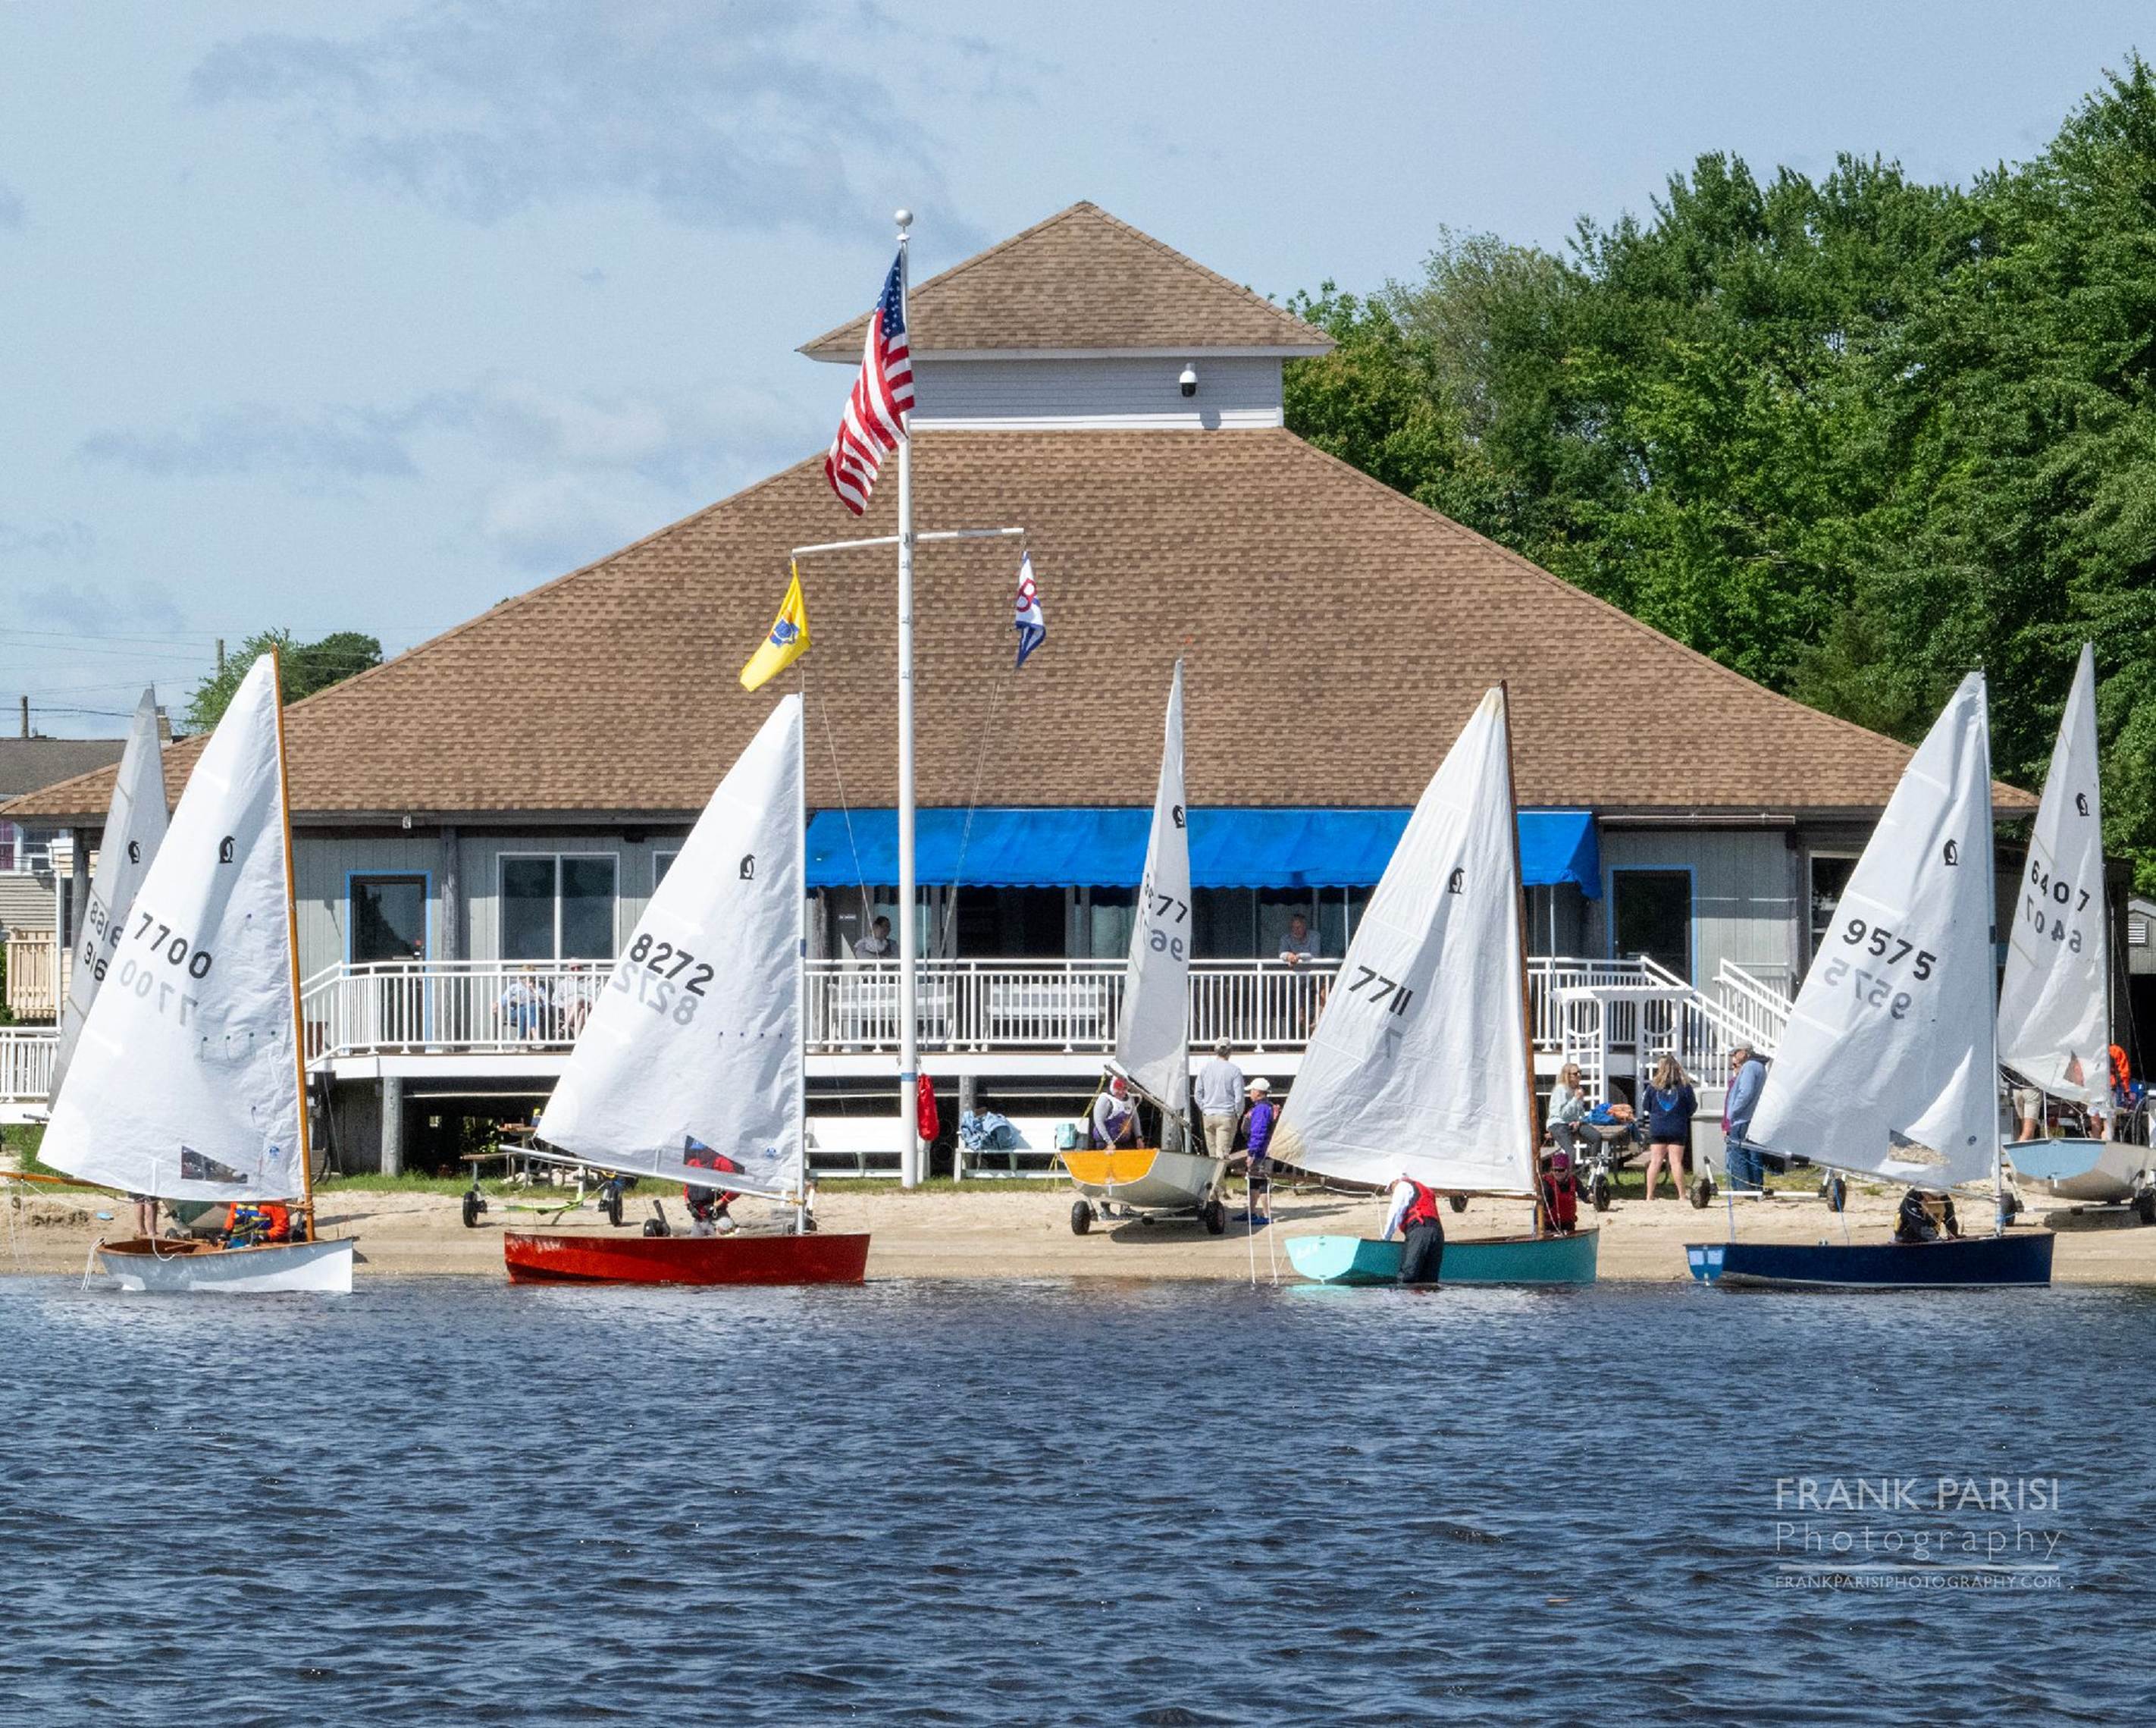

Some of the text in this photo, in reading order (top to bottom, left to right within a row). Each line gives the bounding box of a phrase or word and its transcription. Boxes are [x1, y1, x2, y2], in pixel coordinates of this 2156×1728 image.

[2032, 860, 2090, 911] 6407
[84, 941, 108, 982] 916
[133, 911, 212, 980] 7700
[630, 933, 714, 997] 8272
[1842, 919, 1937, 981] 9575
[1349, 965, 1414, 1017] 7711
